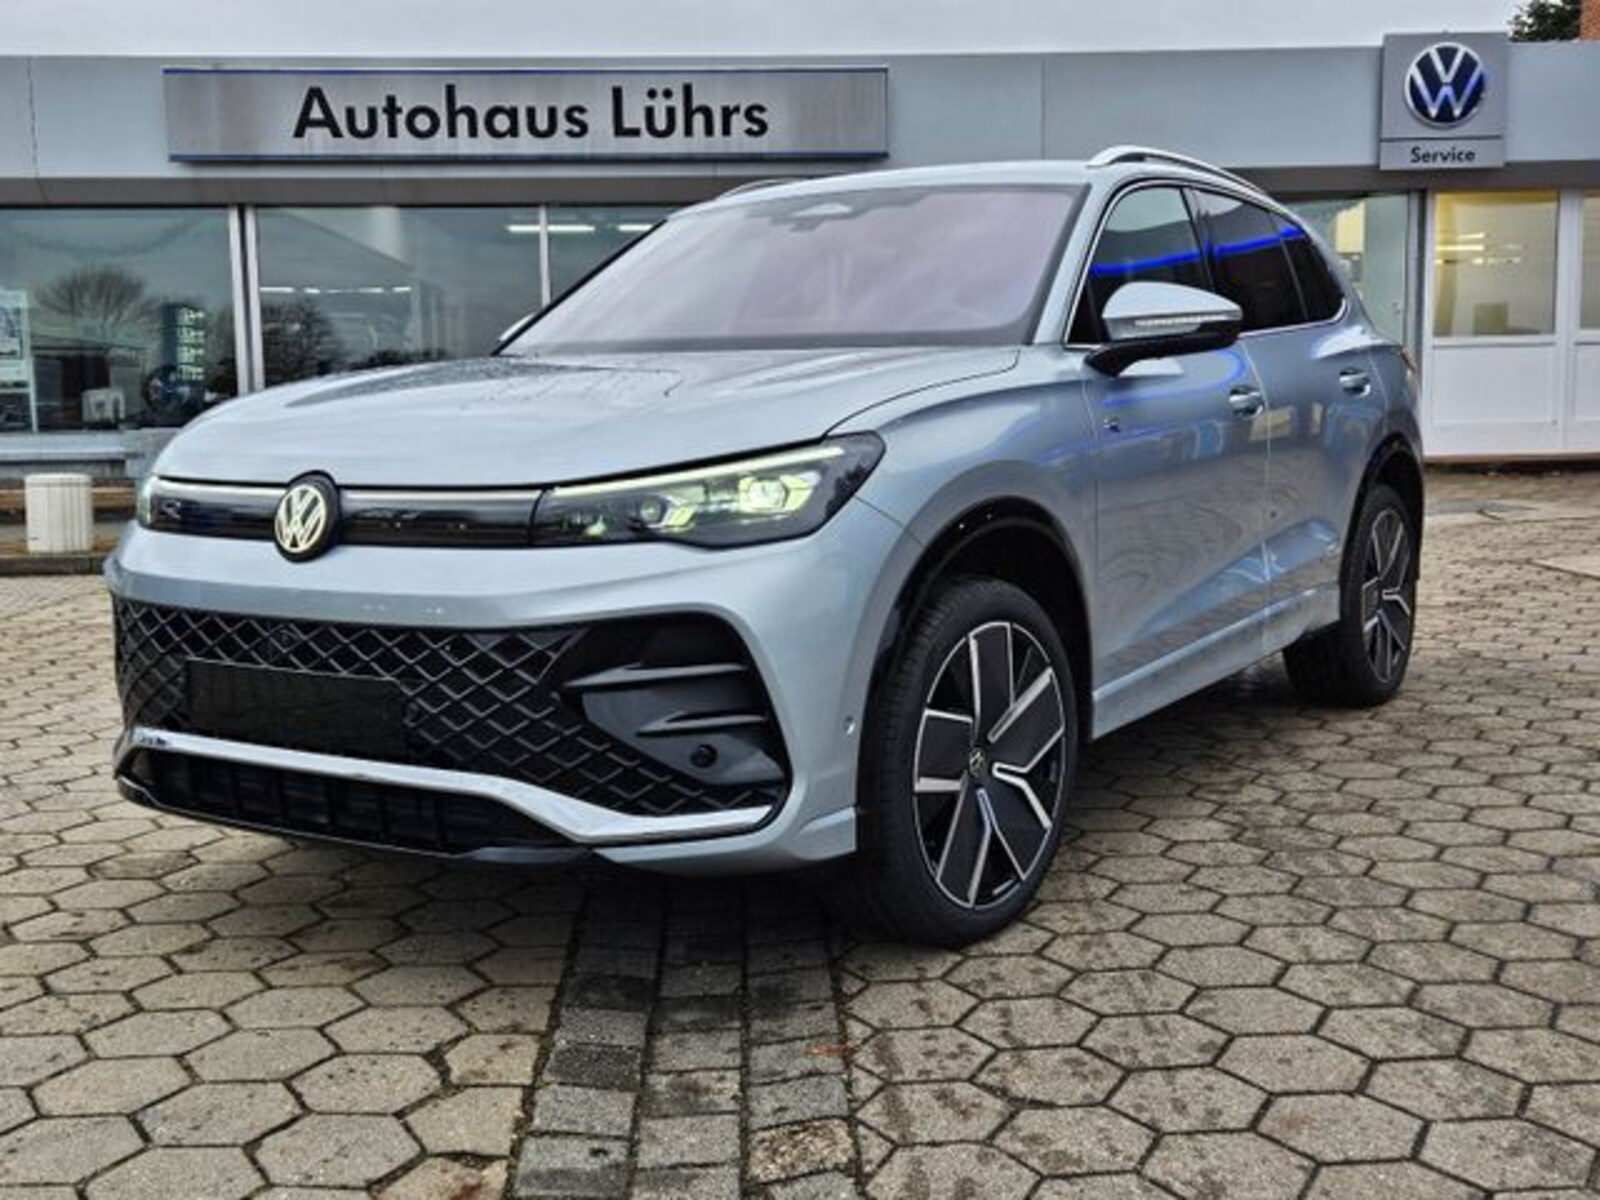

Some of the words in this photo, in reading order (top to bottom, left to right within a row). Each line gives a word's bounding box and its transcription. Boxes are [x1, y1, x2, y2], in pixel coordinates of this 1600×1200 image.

[292, 83, 589, 140] Autohaus
[611, 82, 769, 139] Lührs
[1410, 146, 1476, 163] Service
